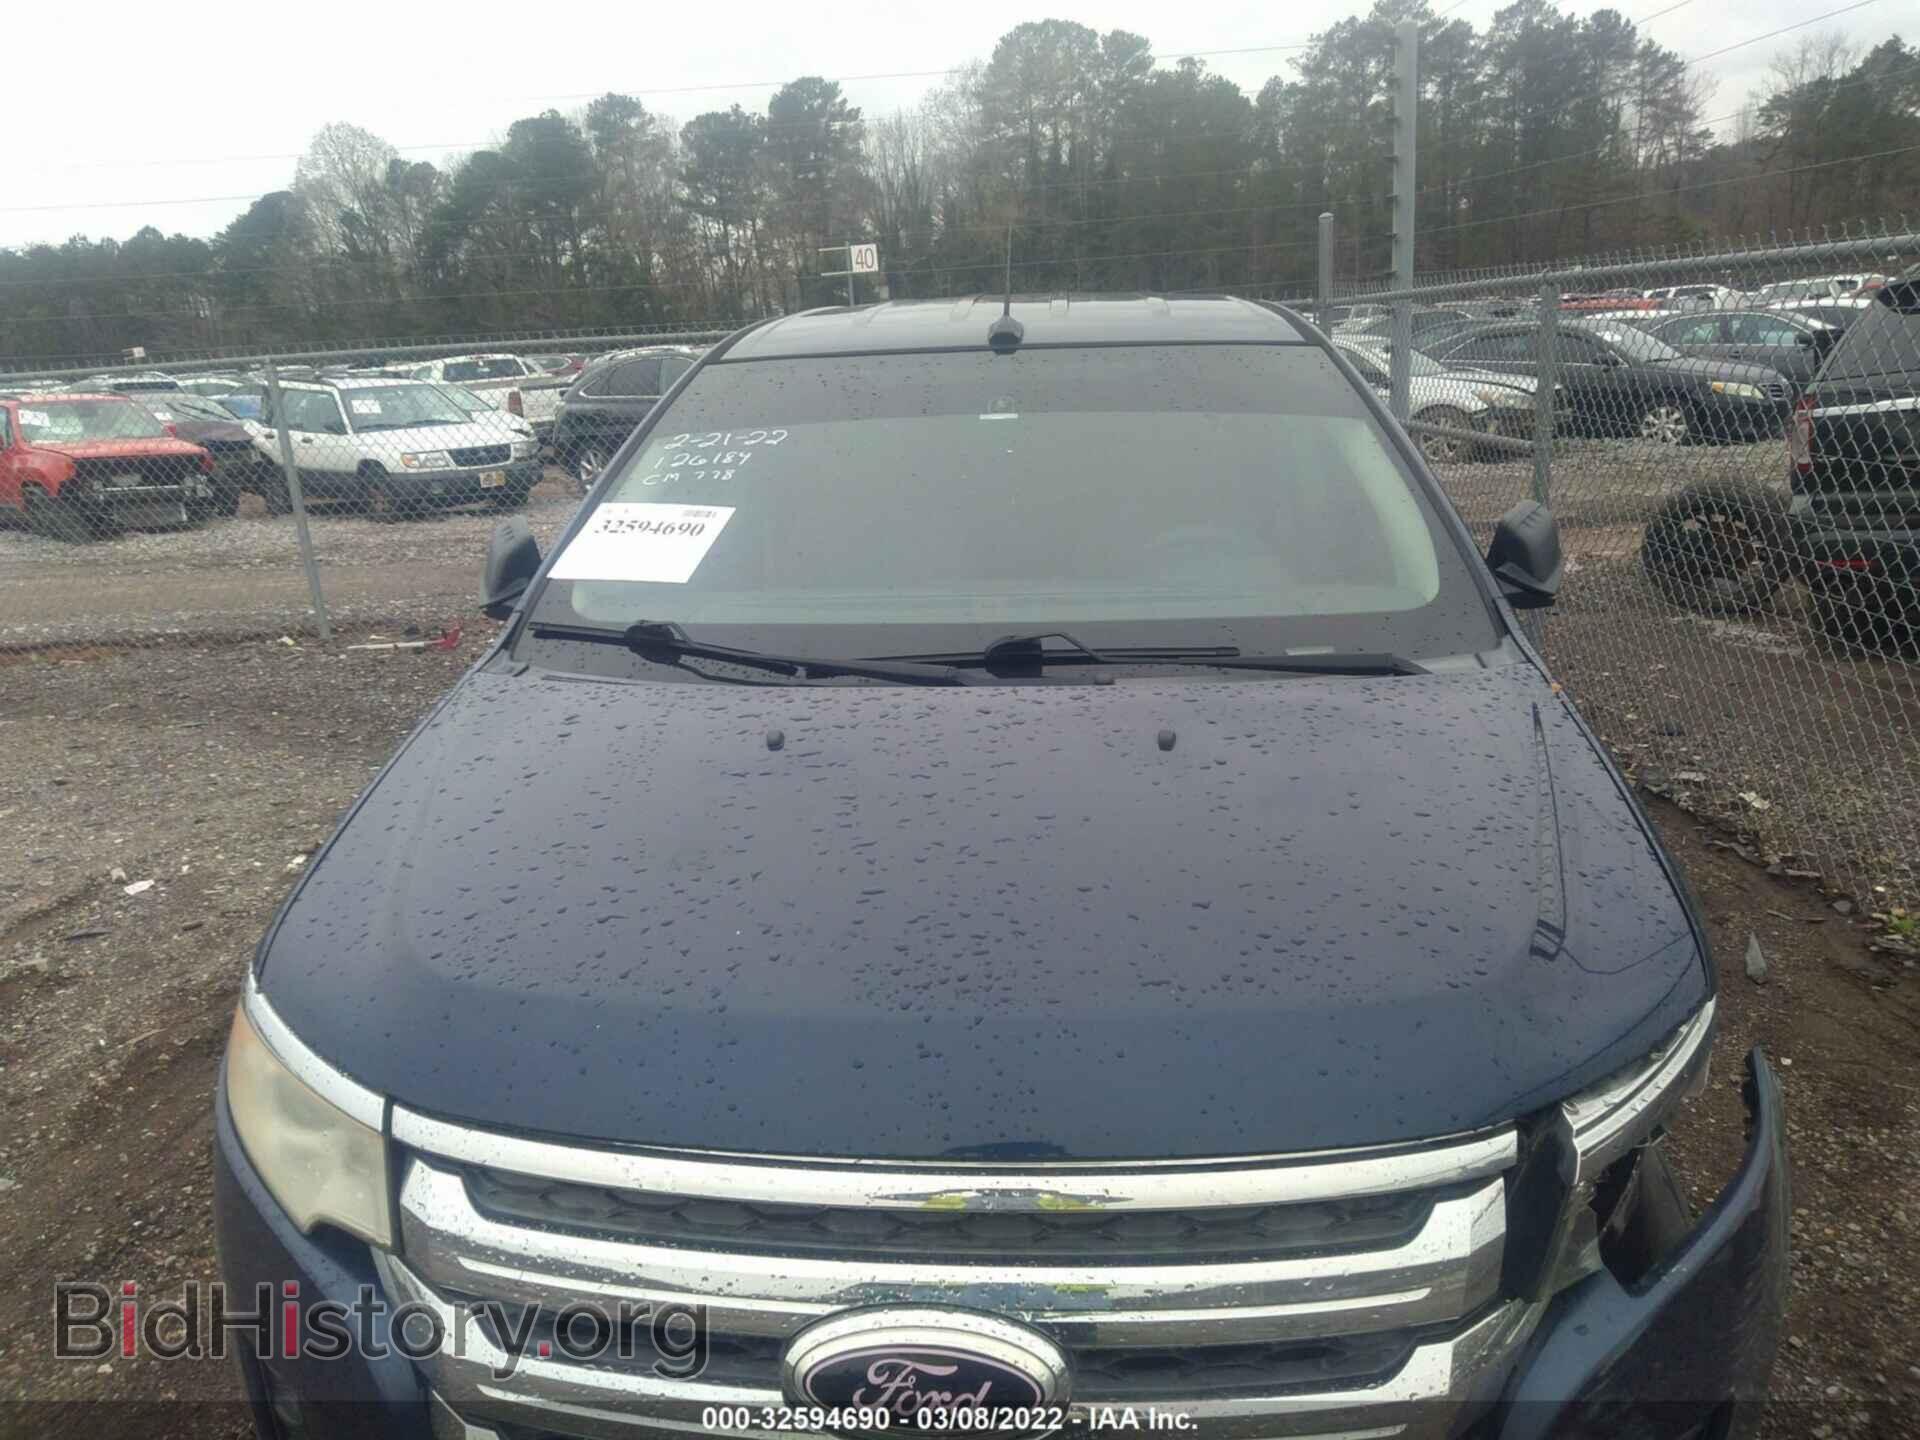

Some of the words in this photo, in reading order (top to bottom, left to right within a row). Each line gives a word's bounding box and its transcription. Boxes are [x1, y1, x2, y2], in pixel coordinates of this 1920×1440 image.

[855, 247, 875, 269] 40
[664, 429, 788, 449] 2-21-22
[642, 472, 680, 486] CM
[593, 519, 705, 536] 32594690
[852, 1358, 993, 1416] Ford
